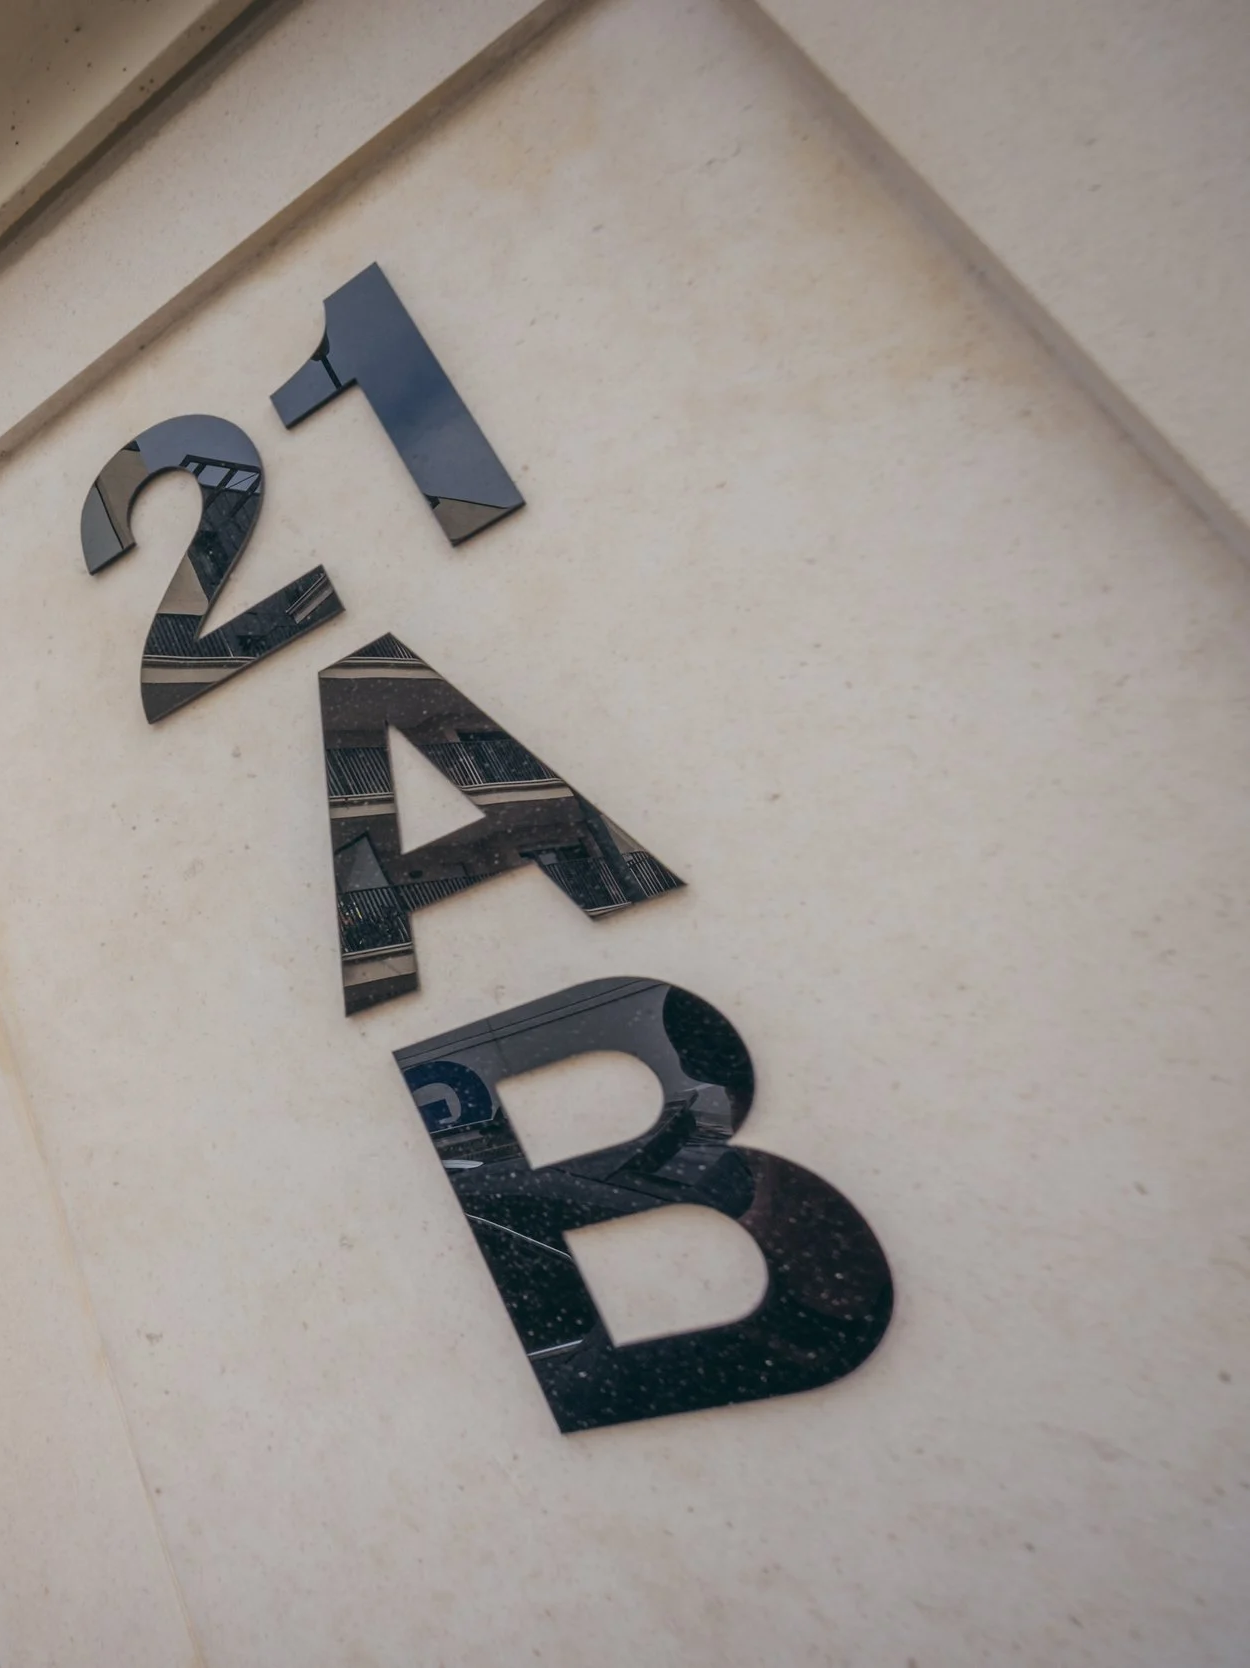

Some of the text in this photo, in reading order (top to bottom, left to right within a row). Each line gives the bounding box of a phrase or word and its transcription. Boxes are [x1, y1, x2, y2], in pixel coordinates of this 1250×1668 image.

[80, 262, 525, 724] 21
[318, 632, 687, 1018] A
[392, 976, 894, 1434] B
